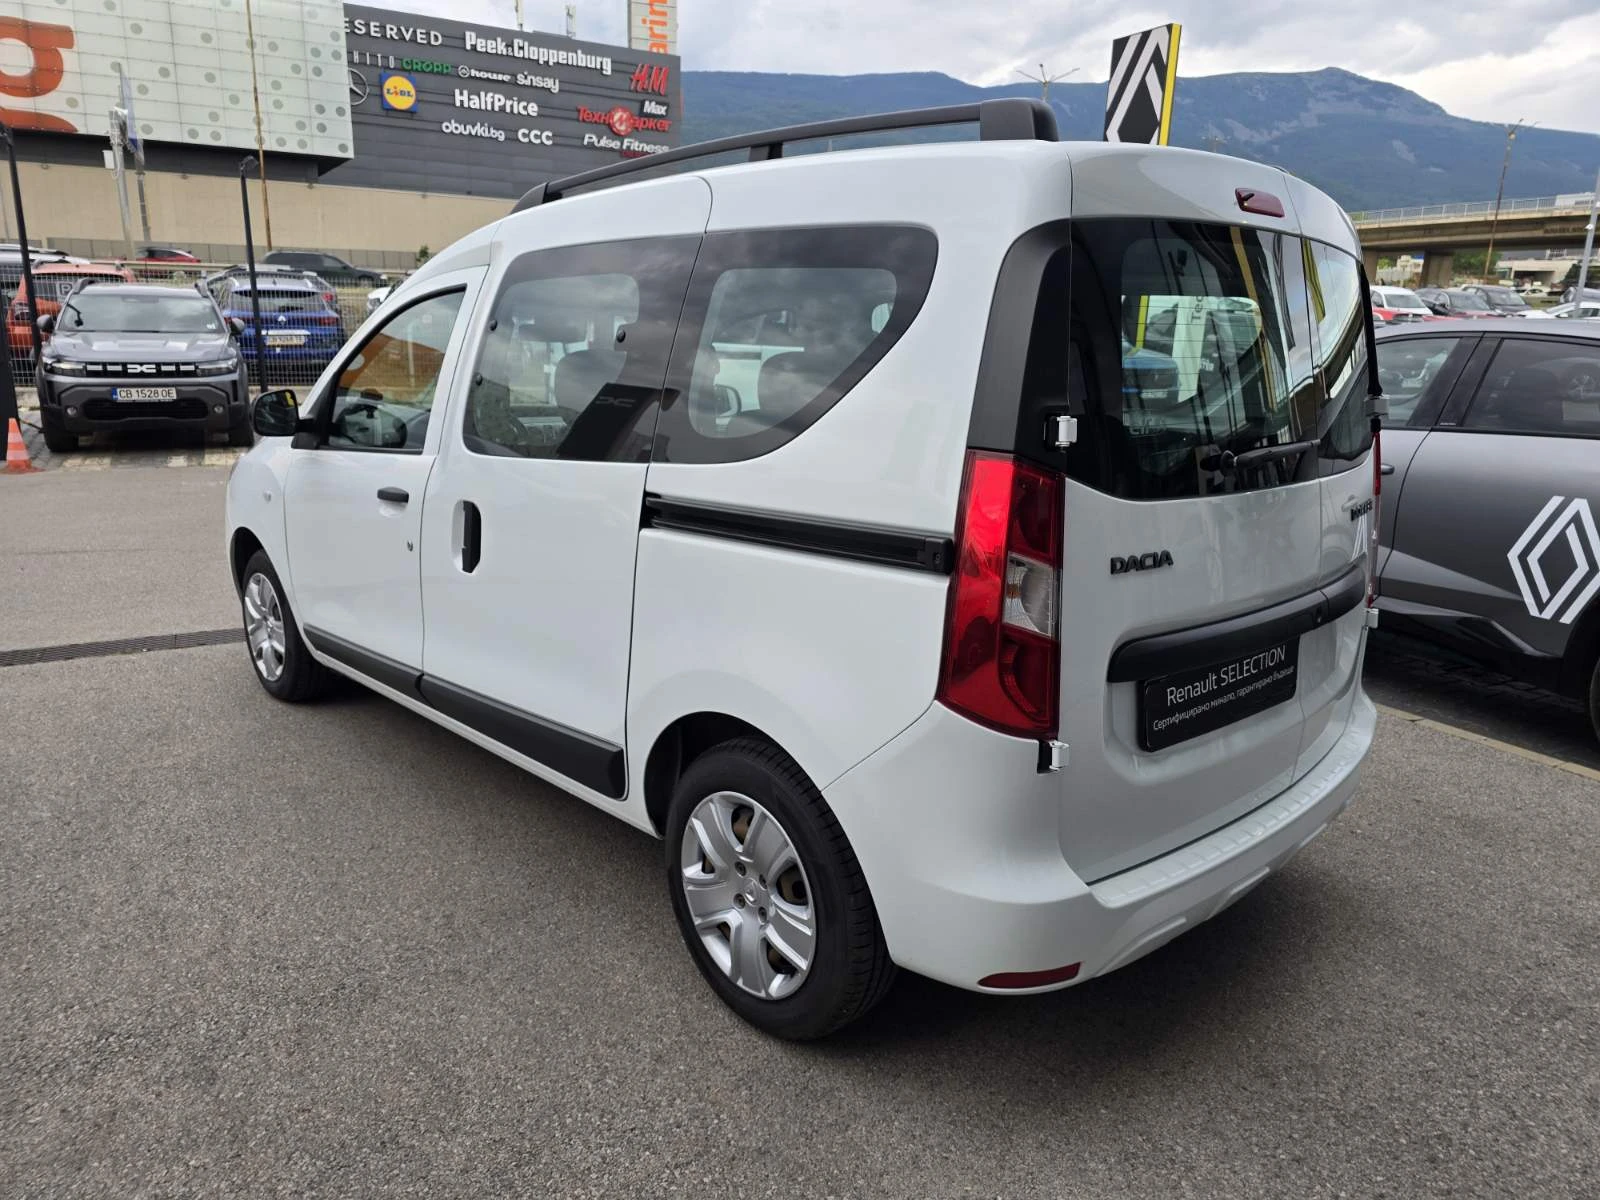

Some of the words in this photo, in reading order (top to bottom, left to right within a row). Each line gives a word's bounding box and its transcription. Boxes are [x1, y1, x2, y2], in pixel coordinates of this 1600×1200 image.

[471, 69, 511, 82] house
[454, 89, 539, 117] HalfPrice
[643, 100, 668, 116] Max
[442, 119, 506, 141] obuvki.bg
[583, 133, 621, 149] Pulse
[1110, 549, 1174, 575] DACIA
[1166, 672, 1218, 707] Renault
[1220, 644, 1287, 687] SELECTION
